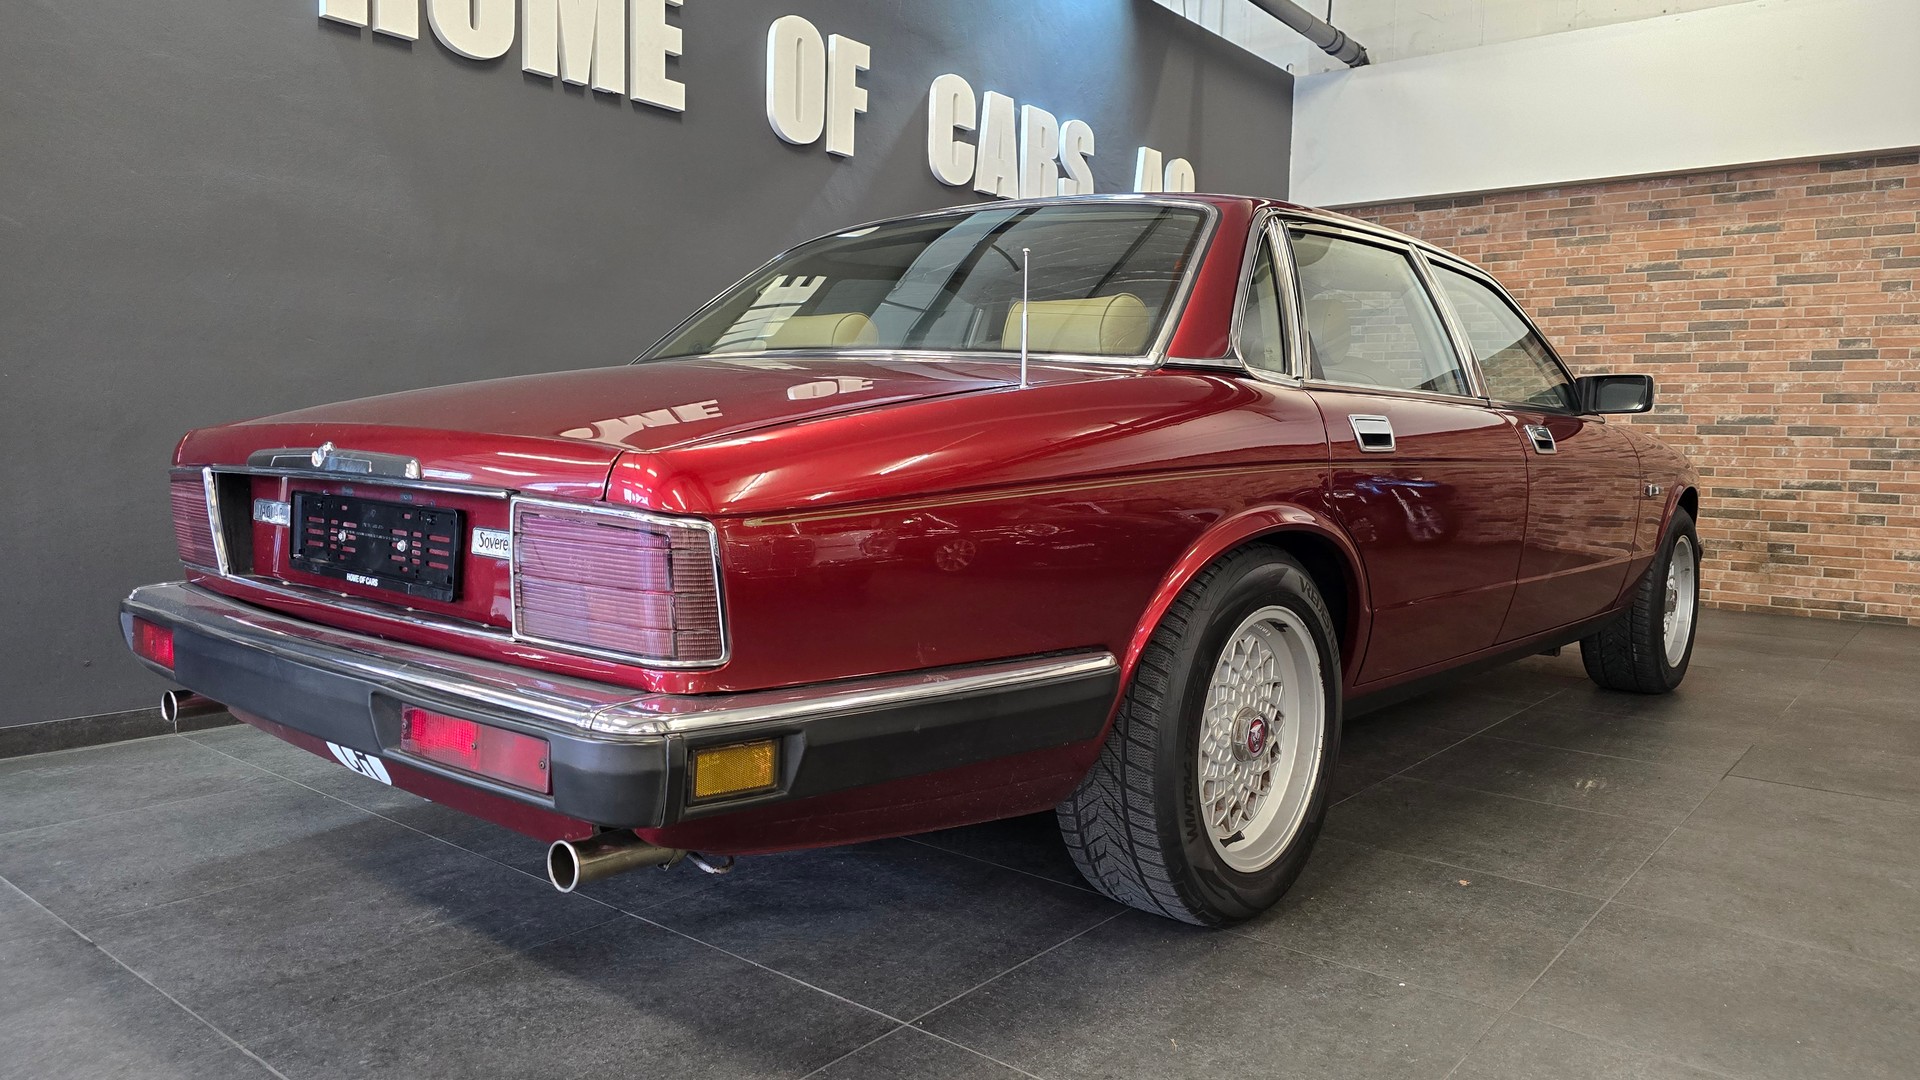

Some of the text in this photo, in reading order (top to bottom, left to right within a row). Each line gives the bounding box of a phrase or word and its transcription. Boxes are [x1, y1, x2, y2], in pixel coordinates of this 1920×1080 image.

[766, 15, 870, 157] OF
[928, 73, 1094, 199] CARS
[346, 572, 379, 587] HOME OF CARS
